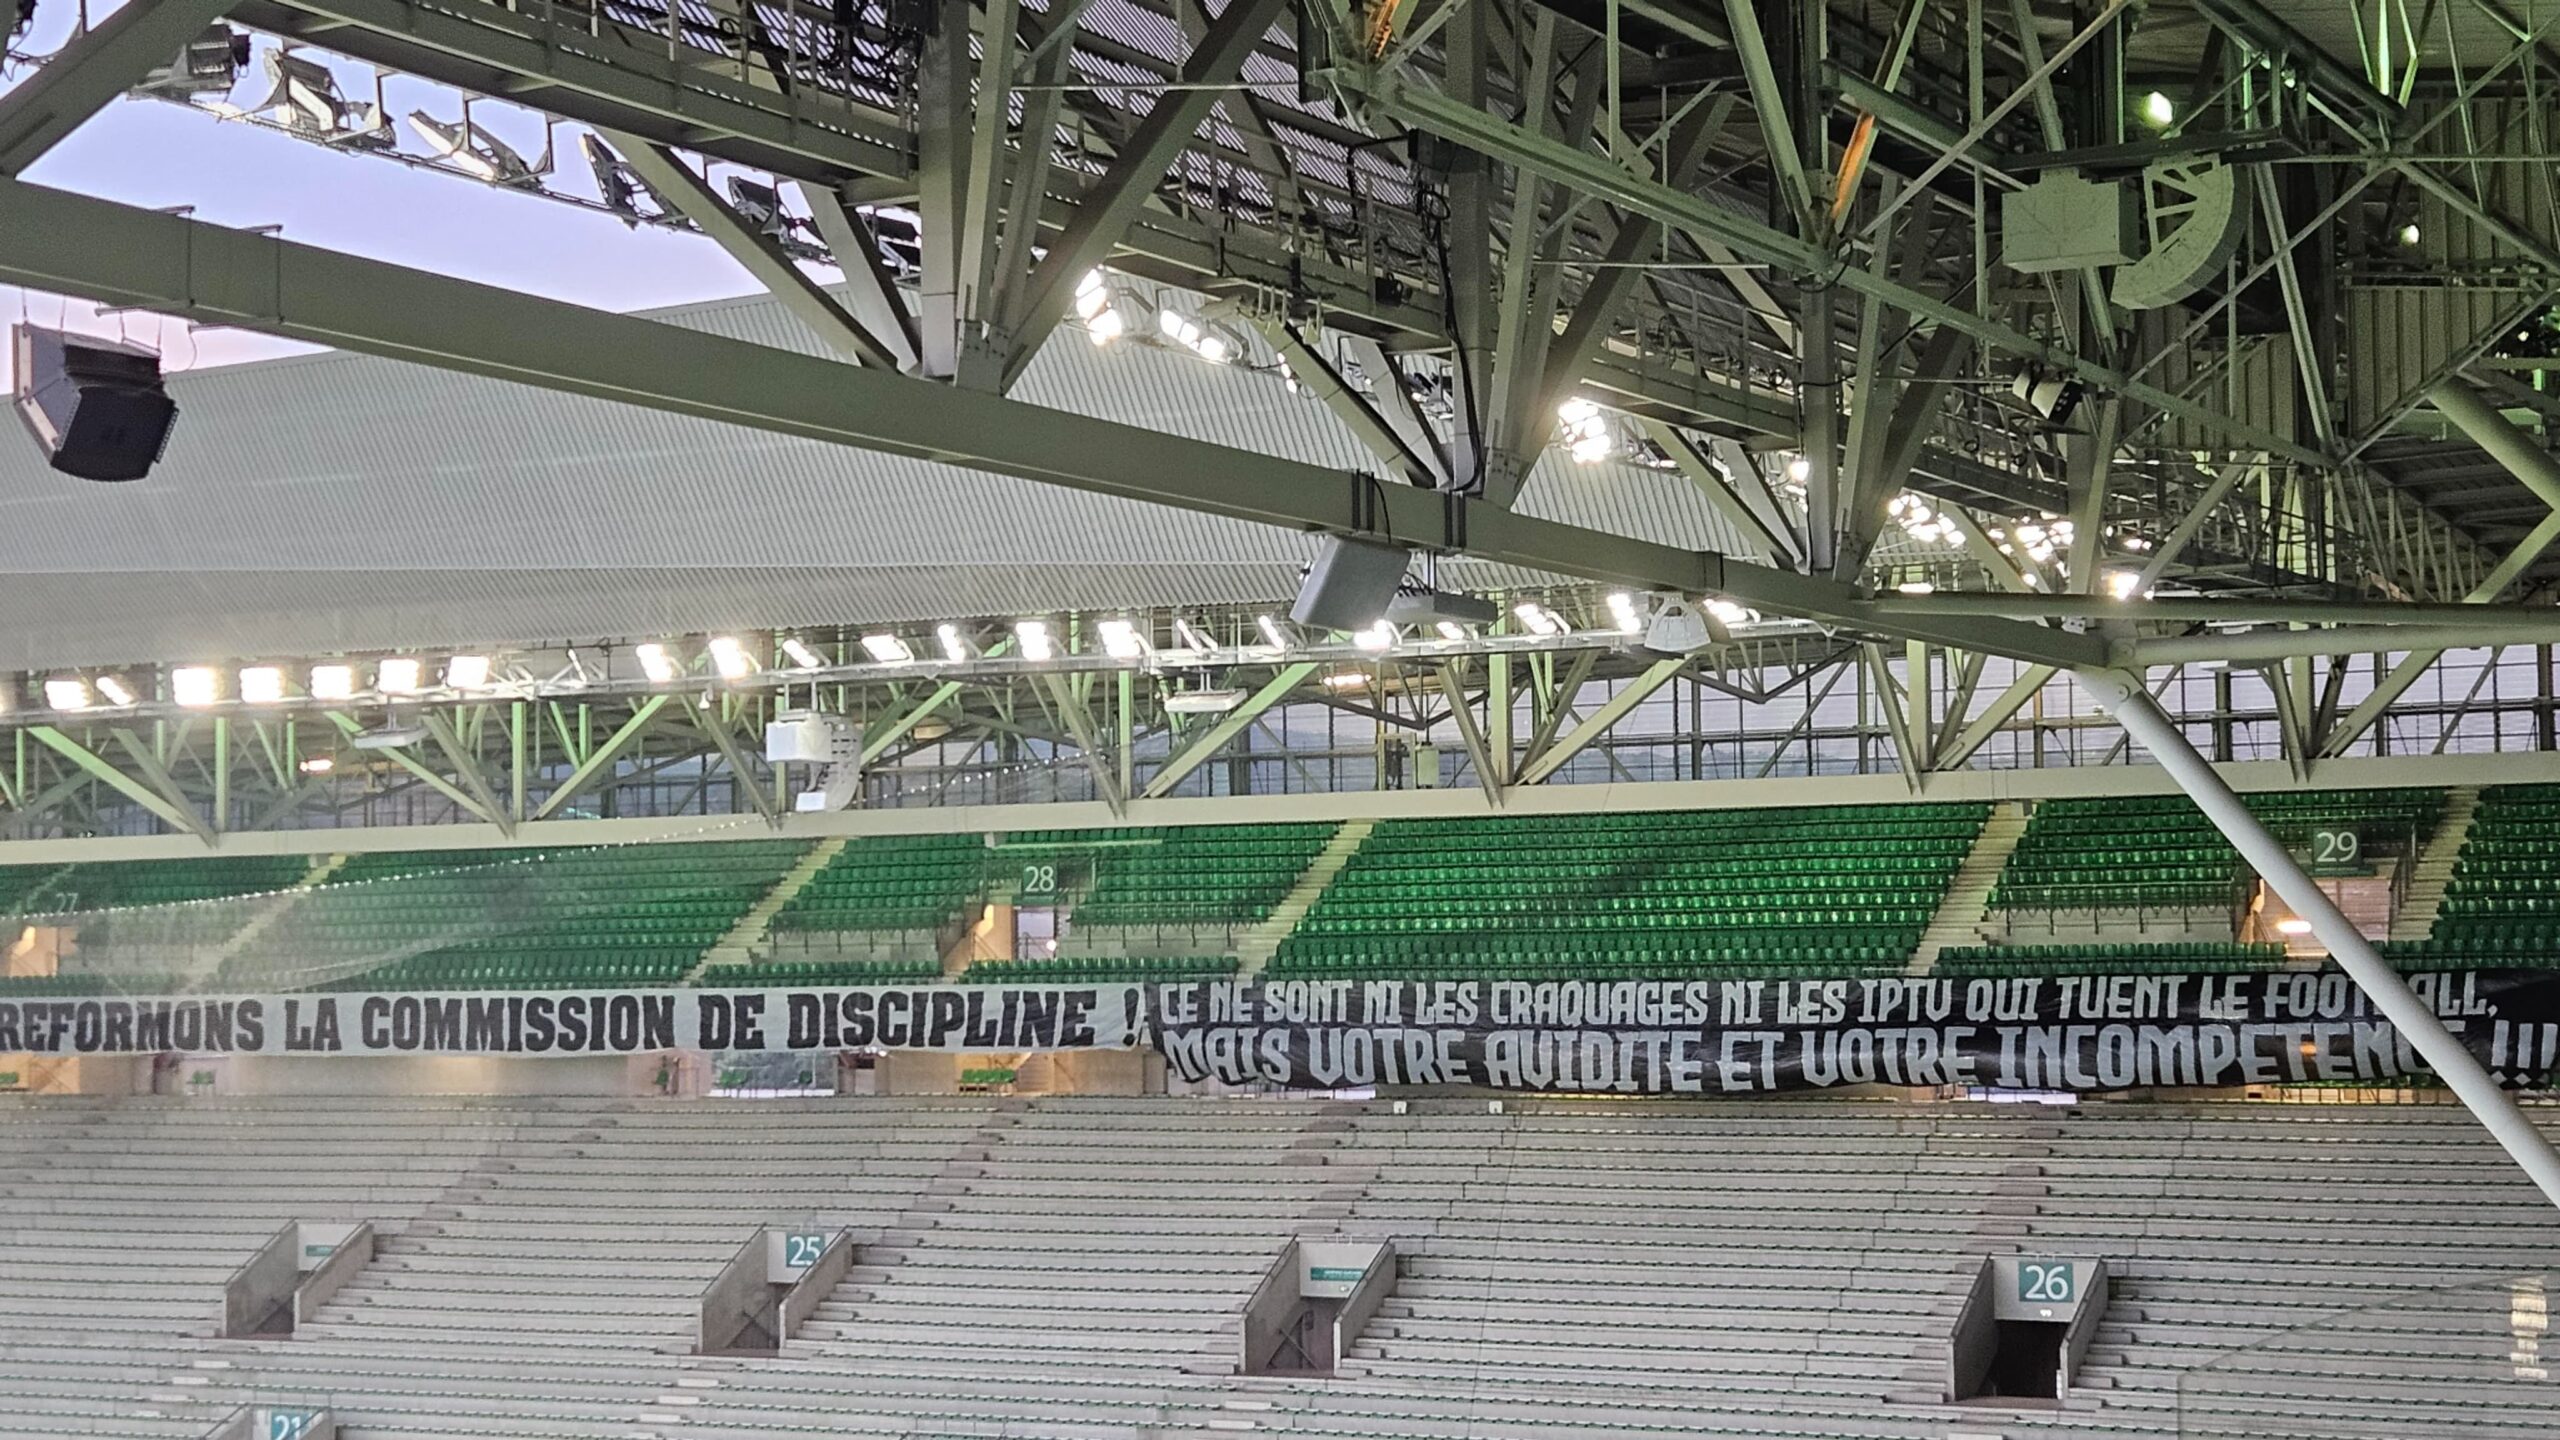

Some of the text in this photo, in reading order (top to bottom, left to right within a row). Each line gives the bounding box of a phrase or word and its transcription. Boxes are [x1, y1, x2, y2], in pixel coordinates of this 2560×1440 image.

[2316, 831, 2358, 862] 29
[1024, 865, 1055, 892] 28
[55, 892, 79, 914] 27
[1159, 983, 1199, 1024] CE
[1209, 981, 1254, 1024] NE
[1263, 980, 1354, 1024] SONT
[1363, 980, 1404, 1024] NI
[1414, 981, 1479, 1025] LES
[1490, 980, 1708, 1029] CRAQUAGES
[1719, 981, 1766, 1025] NI
[1778, 980, 1848, 1025] LES
[1855, 979, 1953, 1023] IPTV
[1966, 978, 2048, 1023] QUI
[2056, 976, 2189, 1020] TUENT
[2200, 974, 2251, 1021] LE
[0, 988, 1139, 1052] REFORMONS LA COMMISSION DE DISCIPLINE !
[1162, 1027, 1292, 1085] MAIS
[1308, 1027, 1475, 1086] VOTRE
[1483, 1029, 1703, 1091] AVIDITE
[1715, 1031, 1785, 1091] ET
[1801, 1026, 1979, 1087] VOTRE
[1994, 1020, 2466, 1089] INCOMPETENC
[789, 1236, 820, 1265] 25
[2025, 1265, 2068, 1300] 26
